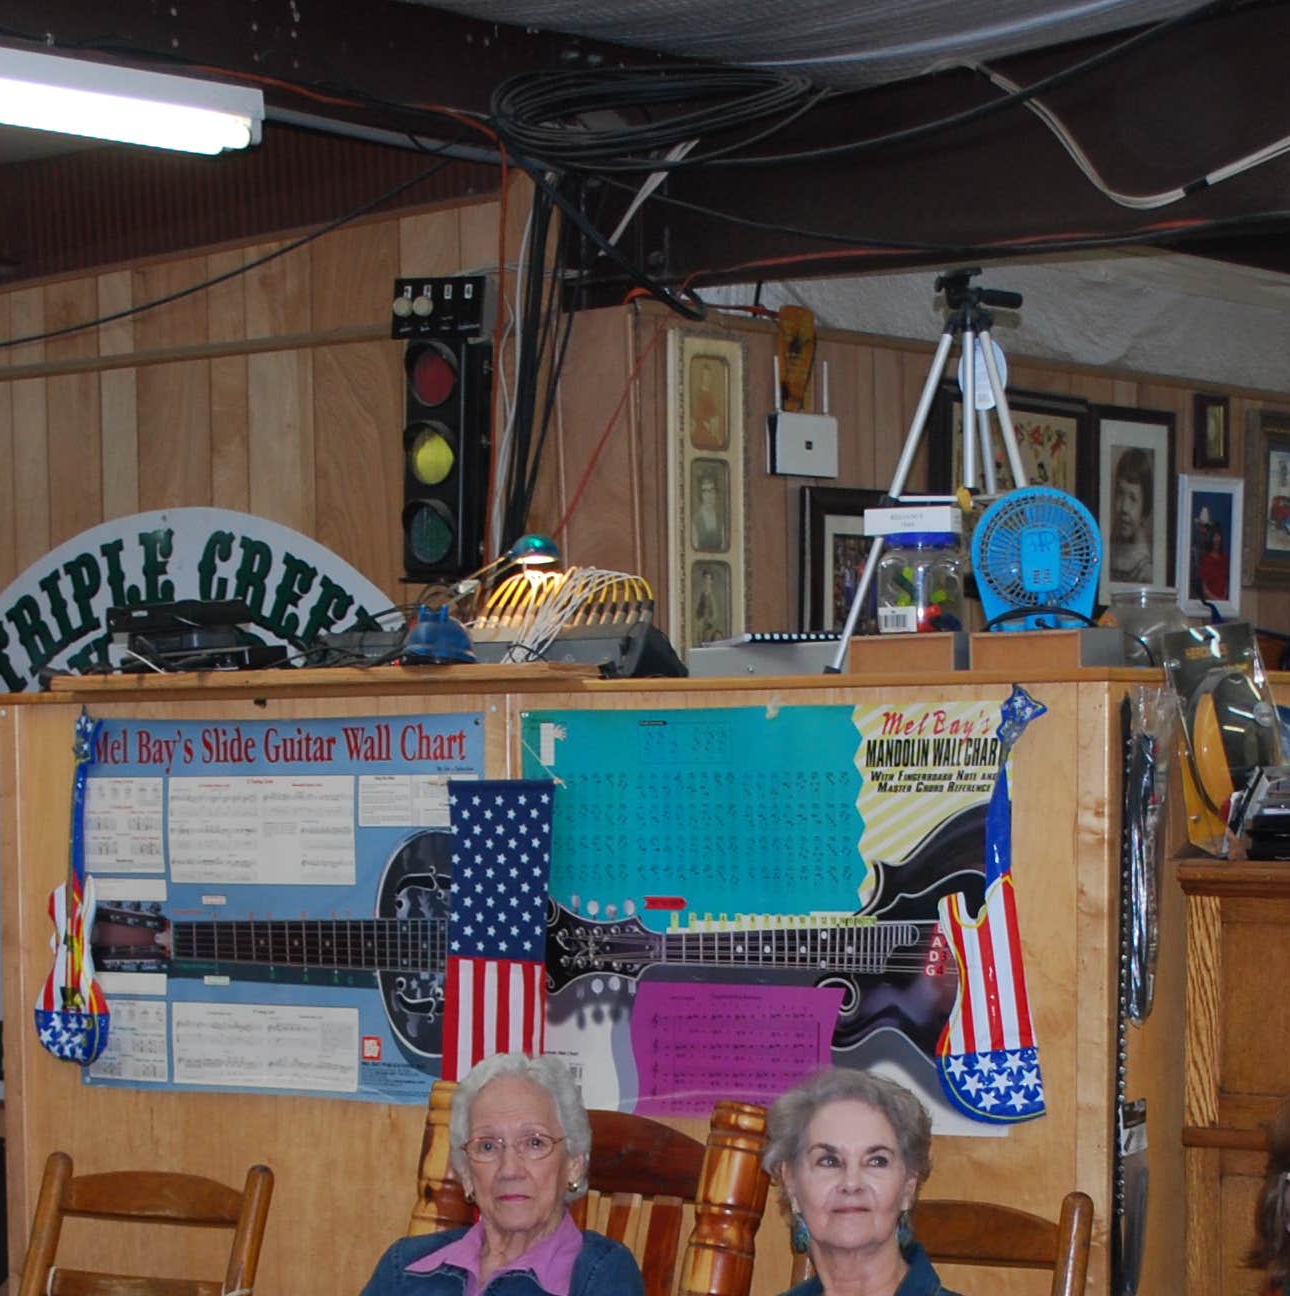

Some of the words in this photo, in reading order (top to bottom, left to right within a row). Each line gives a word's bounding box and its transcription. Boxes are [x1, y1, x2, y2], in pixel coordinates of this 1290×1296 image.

[882, 711, 930, 735] Mel
[932, 709, 992, 744] Bay's
[96, 728, 129, 765] Mel
[137, 729, 194, 775] Bay's
[201, 727, 256, 764] Slide
[264, 727, 337, 764] Guitar
[341, 723, 393, 762] Wall
[400, 722, 467, 761] Chart
[865, 739, 930, 768] MANDOLIN
[932, 738, 961, 767] WALL
[932, 936, 942, 948] A
[929, 950, 939, 962] D
[925, 964, 936, 976] G
